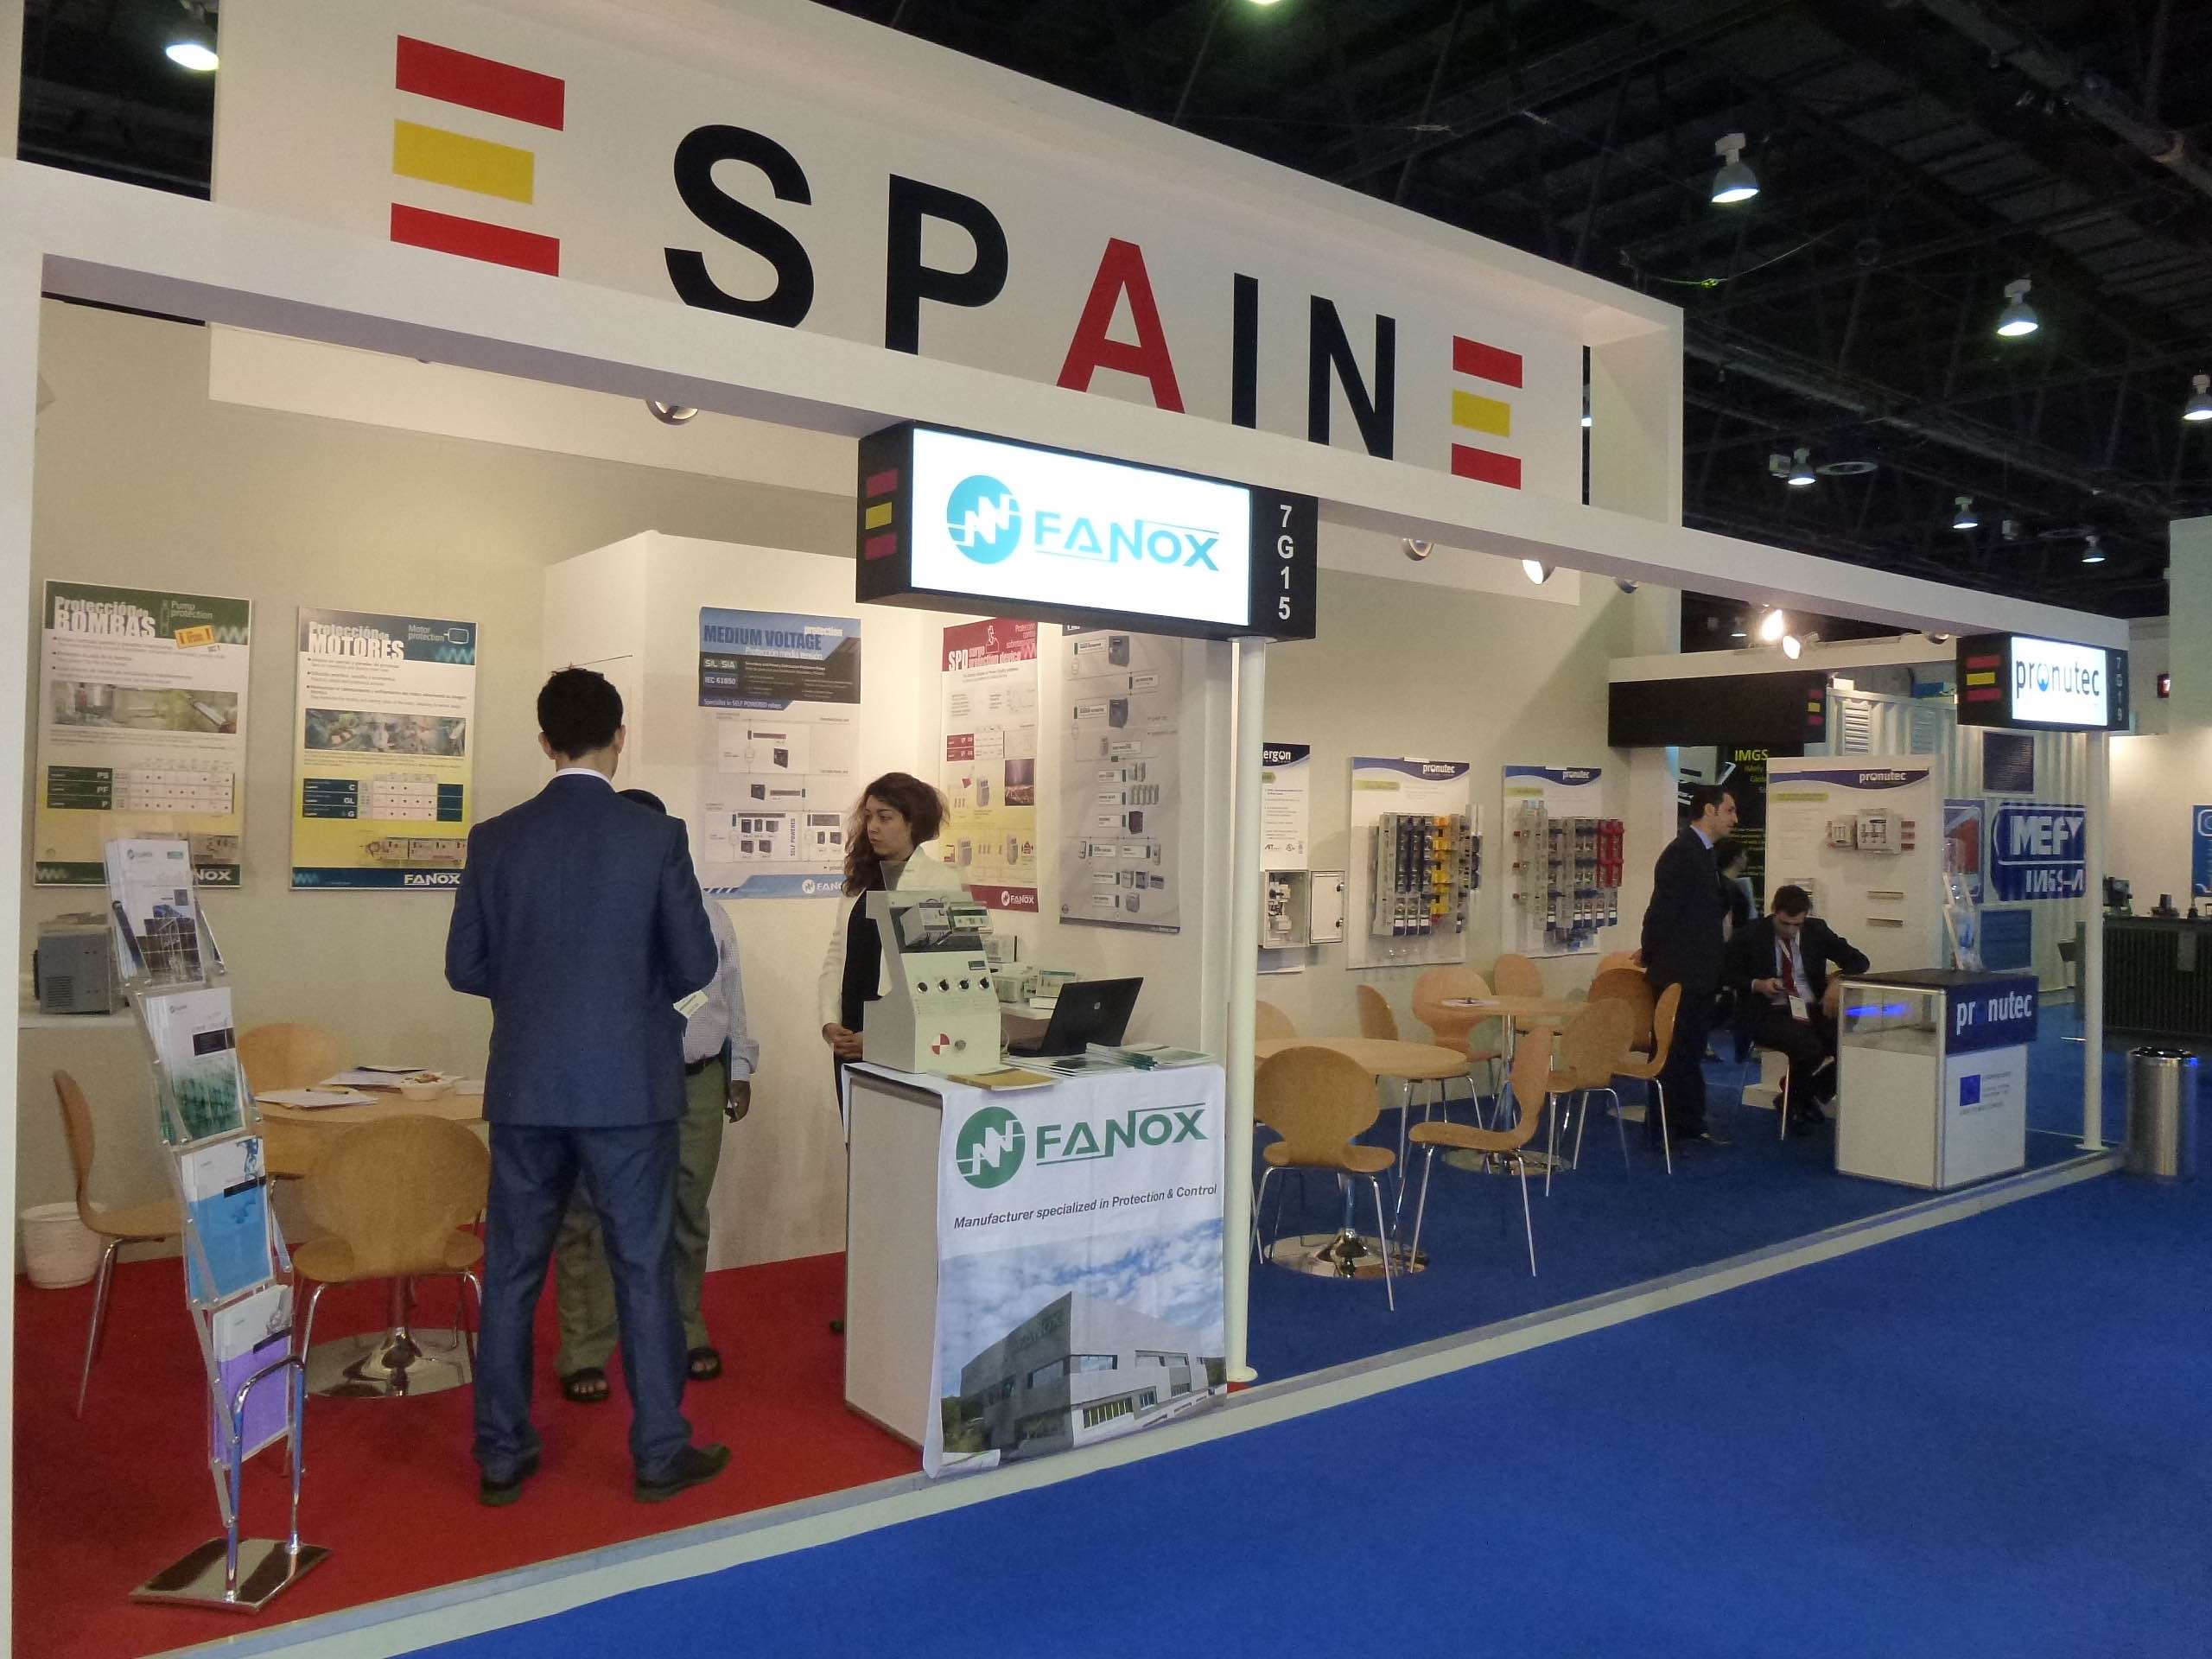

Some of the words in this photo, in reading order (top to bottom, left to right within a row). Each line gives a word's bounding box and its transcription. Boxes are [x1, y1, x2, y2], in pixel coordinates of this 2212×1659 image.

[1035, 510, 1220, 571] FANOX
[54, 610, 156, 638] BOMBAS
[408, 624, 430, 633] Motor
[308, 632, 404, 661] MOTORES
[408, 632, 445, 642] protection
[704, 625, 762, 646] MEDIUM
[766, 630, 822, 651] VOLTAGE
[948, 649, 969, 671] SPD
[1422, 764, 1455, 776] pronutec
[1859, 771, 1907, 784] pronutec
[404, 873, 461, 887] FANOX
[1010, 894, 1034, 905] FANOX
[1036, 1103, 1208, 1166] FANOX
[954, 1209, 1034, 1229] Manufacturer
[1037, 1199, 1097, 1219] specialized
[1099, 1198, 1109, 1209] in
[1112, 1191, 1165, 1209] Protection
[1167, 1189, 1173, 1198] &
[1176, 1185, 1217, 1198] Control
